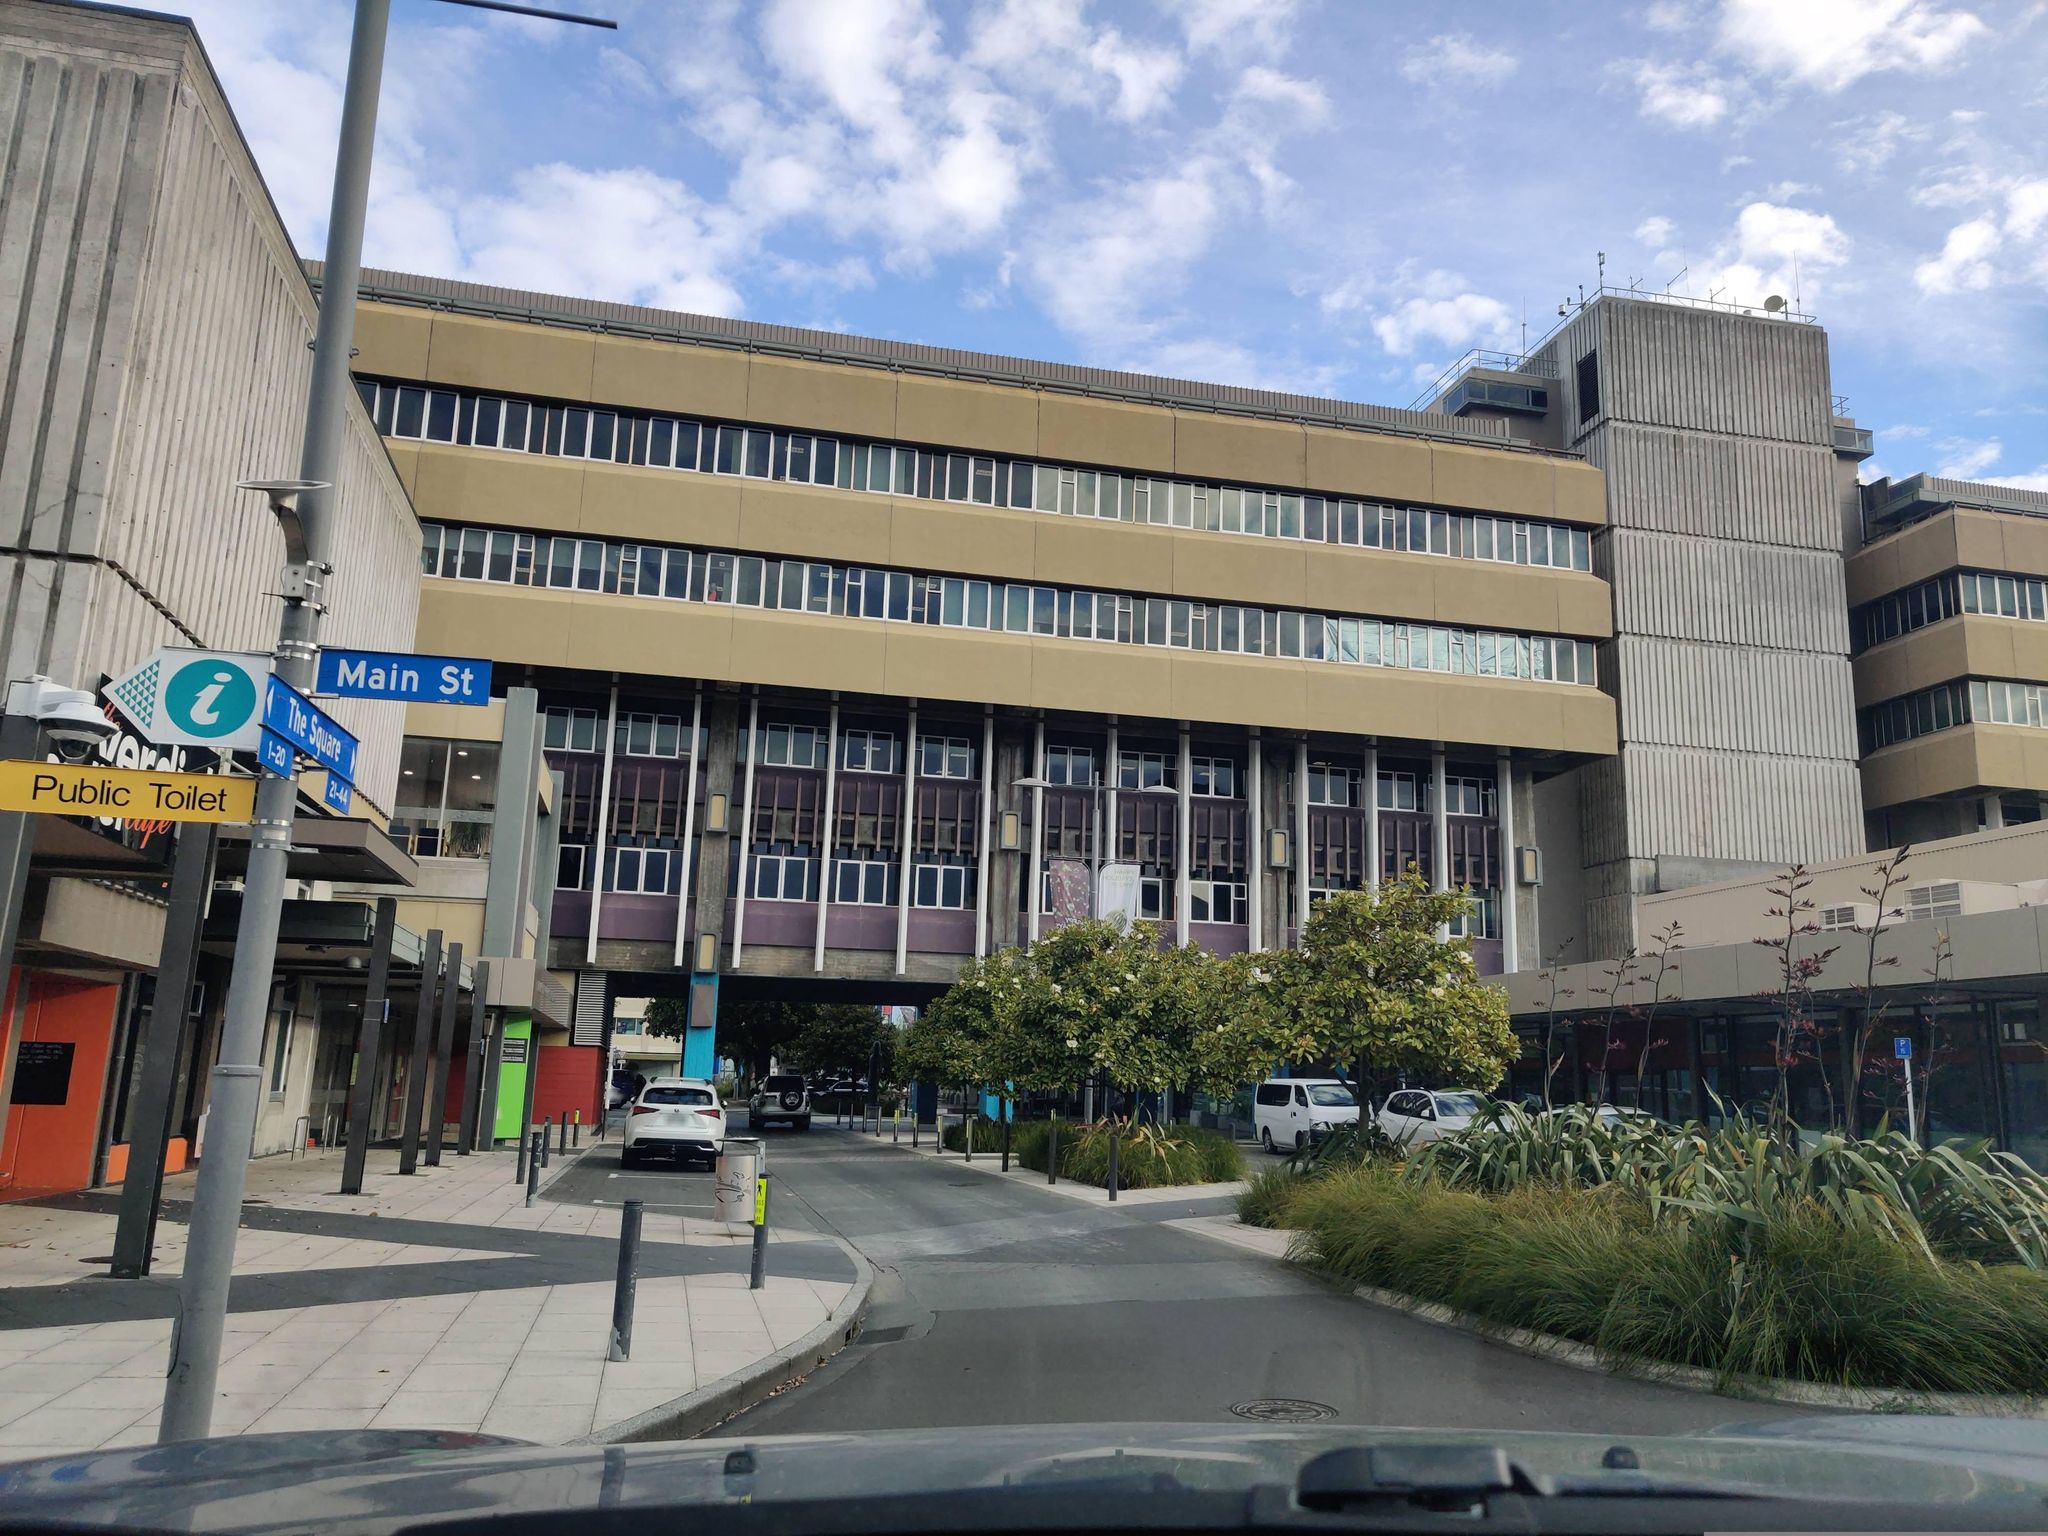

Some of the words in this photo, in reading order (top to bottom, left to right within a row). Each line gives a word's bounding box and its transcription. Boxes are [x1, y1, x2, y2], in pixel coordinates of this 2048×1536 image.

[337, 659, 419, 692] Main
[438, 666, 474, 696] St
[288, 696, 307, 738] The
[309, 714, 341, 762] Square
[267, 740, 286, 767] 1-20
[32, 774, 131, 807] Public
[149, 782, 227, 812] Toilet
[329, 780, 348, 806] 21-44
